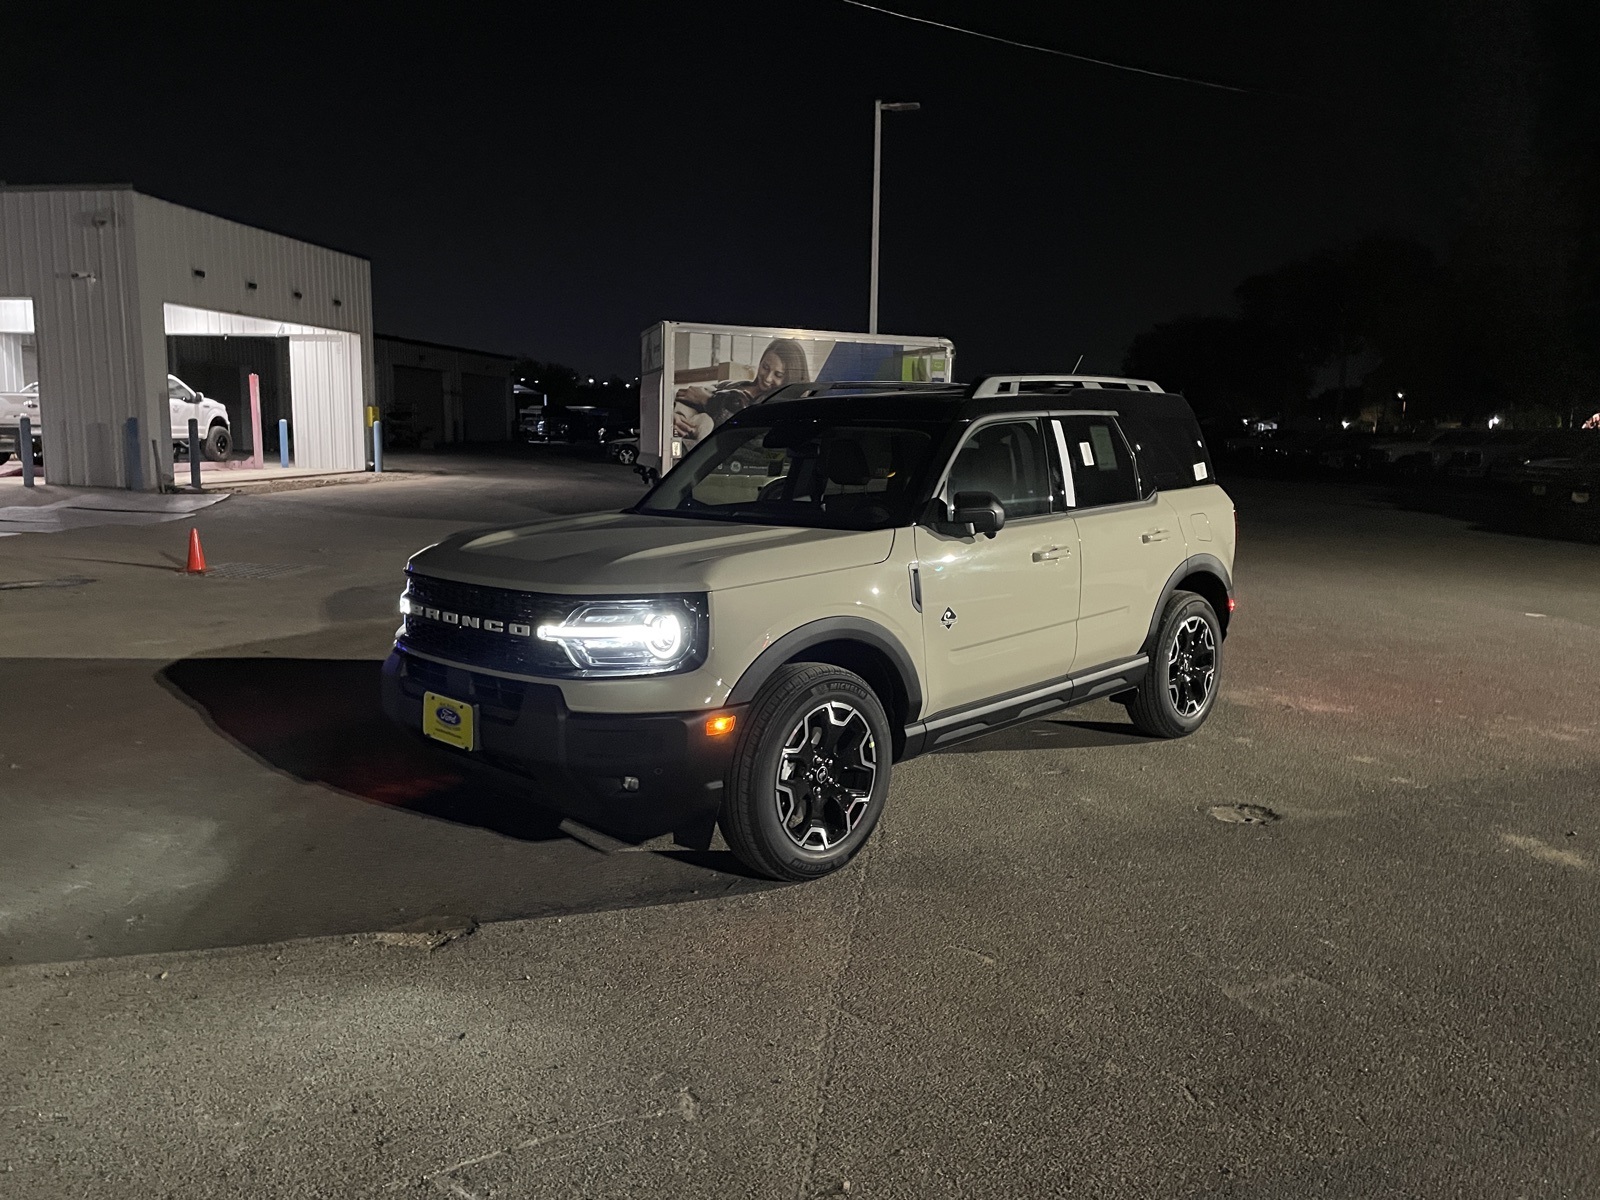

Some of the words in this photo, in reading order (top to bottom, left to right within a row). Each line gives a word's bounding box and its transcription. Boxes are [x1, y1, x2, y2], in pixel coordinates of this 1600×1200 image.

[410, 604, 530, 636] BRONCO
[830, 682, 867, 698] MICHELIN
[440, 708, 457, 724] Ford
